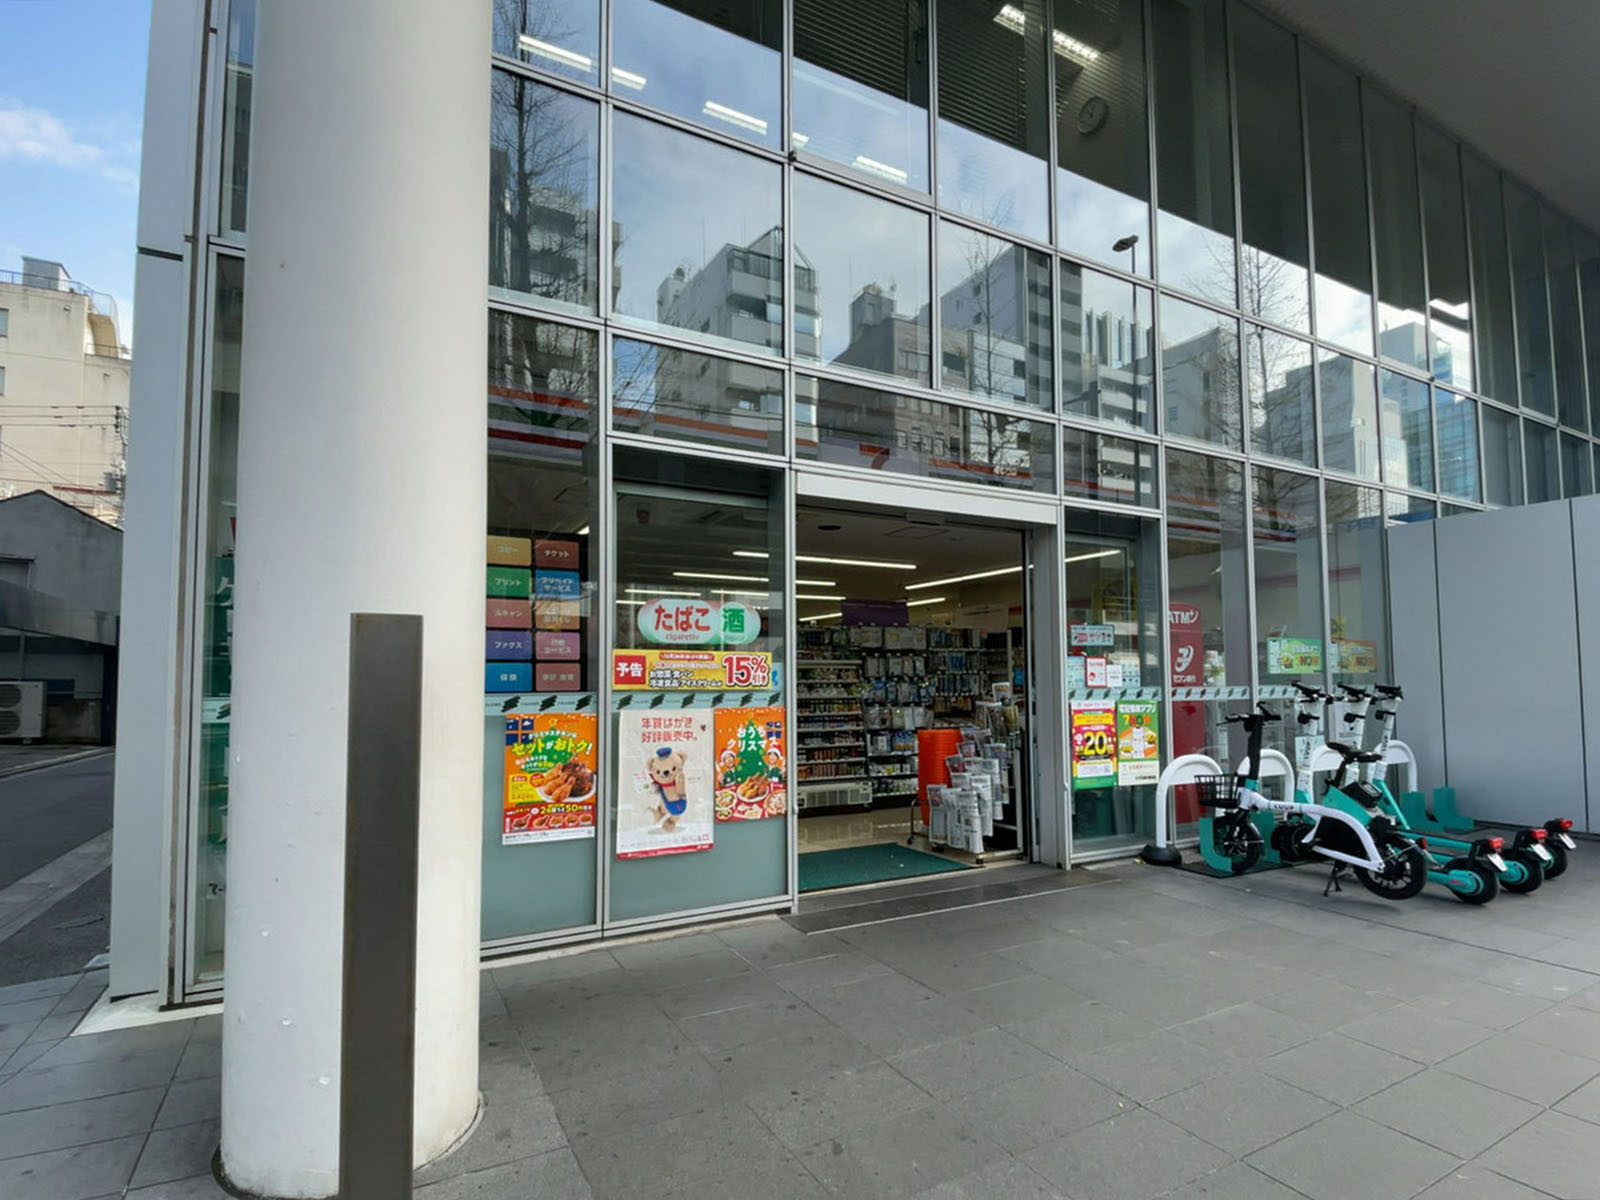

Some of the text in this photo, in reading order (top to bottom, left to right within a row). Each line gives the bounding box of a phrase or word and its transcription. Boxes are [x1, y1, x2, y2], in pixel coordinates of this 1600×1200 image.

[544, 550, 571, 558] チケット
[495, 578, 522, 586] プリント
[495, 609, 523, 617] スキャン
[654, 605, 711, 632] たばこ
[722, 607, 745, 633] 酒
[495, 641, 522, 649] ファクス
[617, 662, 643, 680] 予告
[641, 717, 693, 729] 年賀はがき
[737, 725, 765, 739] おうち
[727, 736, 779, 753] クリスマス
[1083, 730, 1108, 756] 20
